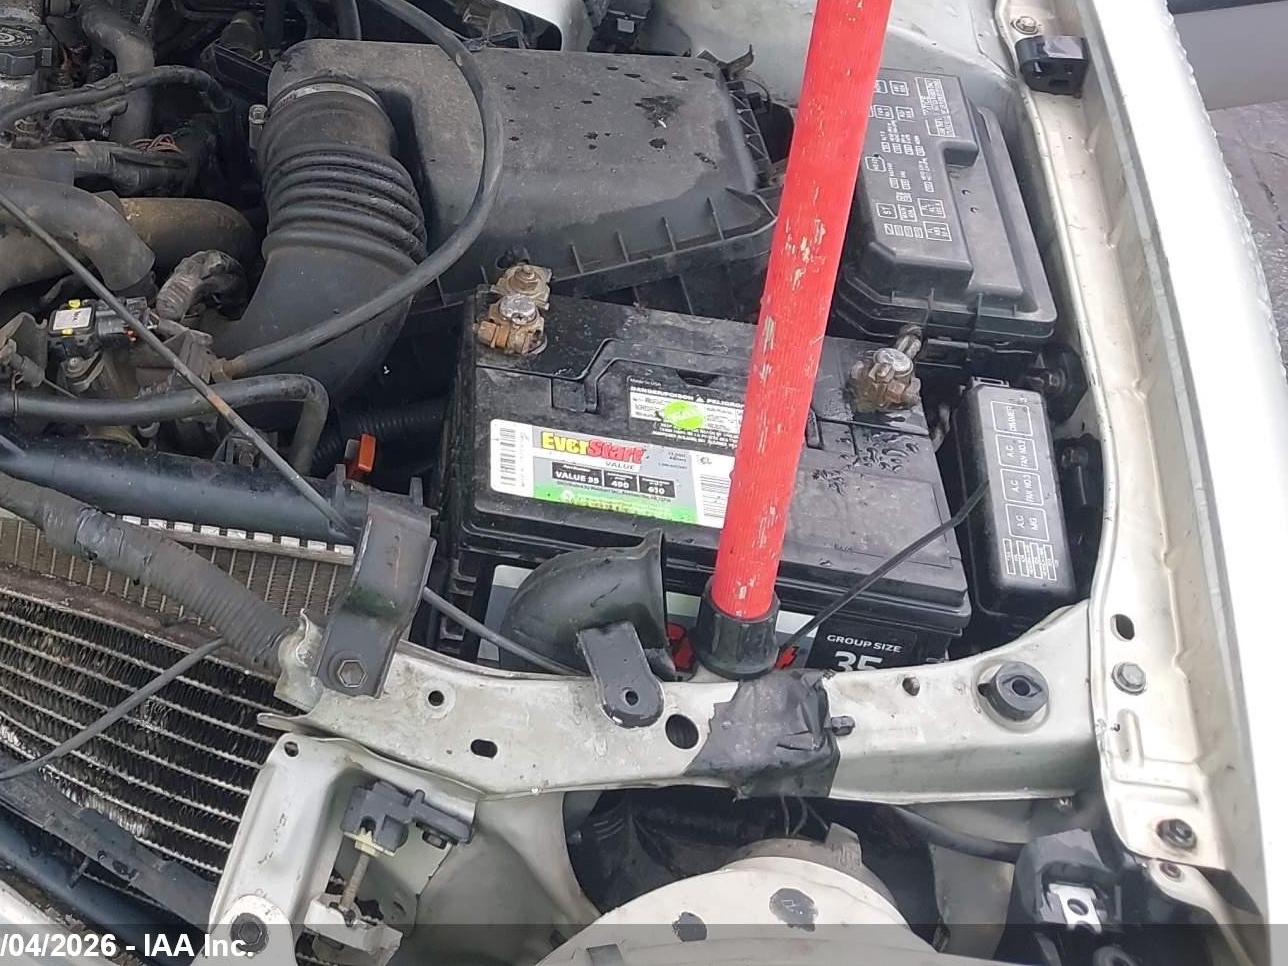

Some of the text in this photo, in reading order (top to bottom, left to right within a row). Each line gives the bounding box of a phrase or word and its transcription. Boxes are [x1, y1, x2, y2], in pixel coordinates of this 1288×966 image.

[541, 430, 648, 465] EverStart
[605, 460, 636, 471] VALUE
[555, 471, 587, 482] VALUE
[610, 480, 630, 489] 490
[826, 634, 903, 653] GROUP SIZE
[834, 650, 883, 672] 35
